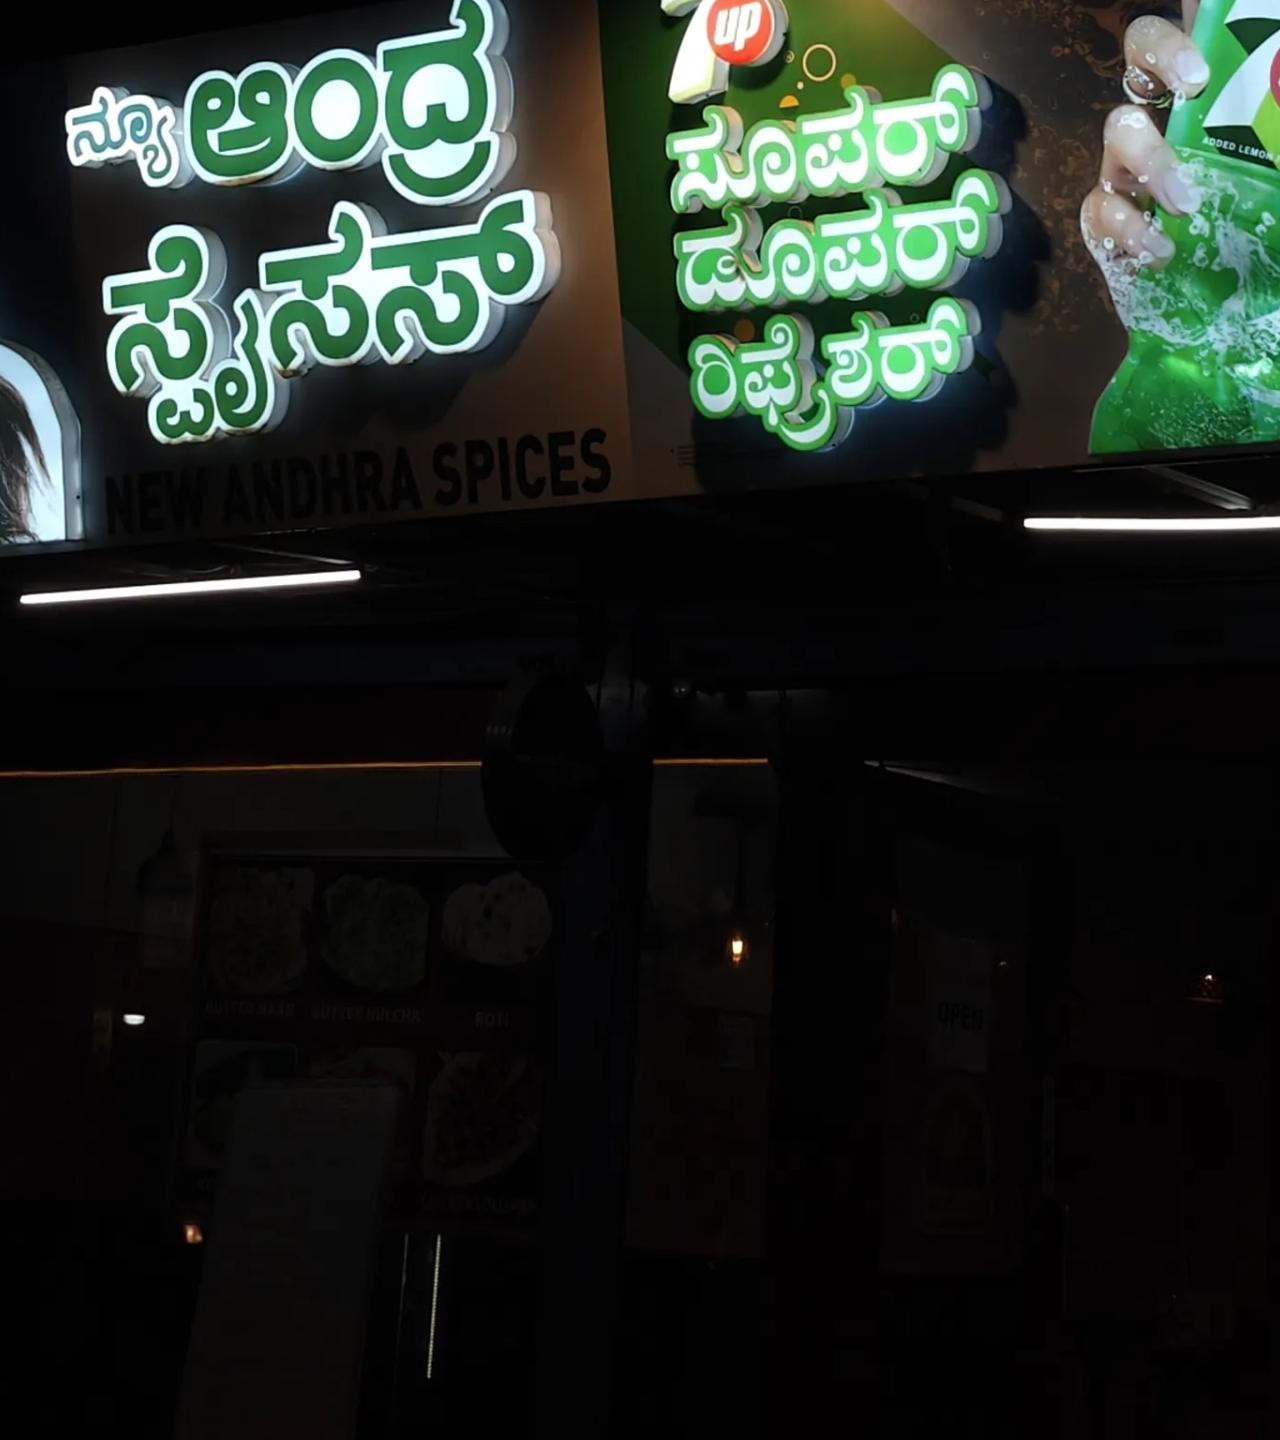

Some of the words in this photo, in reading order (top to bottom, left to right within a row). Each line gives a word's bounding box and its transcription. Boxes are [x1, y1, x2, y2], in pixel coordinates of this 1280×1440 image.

[65, 87, 176, 188] ನ್ಯೂ
[666, 64, 980, 213] ಸೂಪರ್
[1202, 136, 1236, 152] ADDED
[1238, 144, 1274, 162] LEMON
[674, 168, 1000, 311] ಡೂಪರ್
[102, 190, 548, 444] ಸ್ಪೈಸಸ್
[105, 468, 206, 536] NEW
[222, 446, 423, 527] ANDHRA
[432, 428, 612, 508] SPICES
[937, 1000, 985, 1031] OPEN
